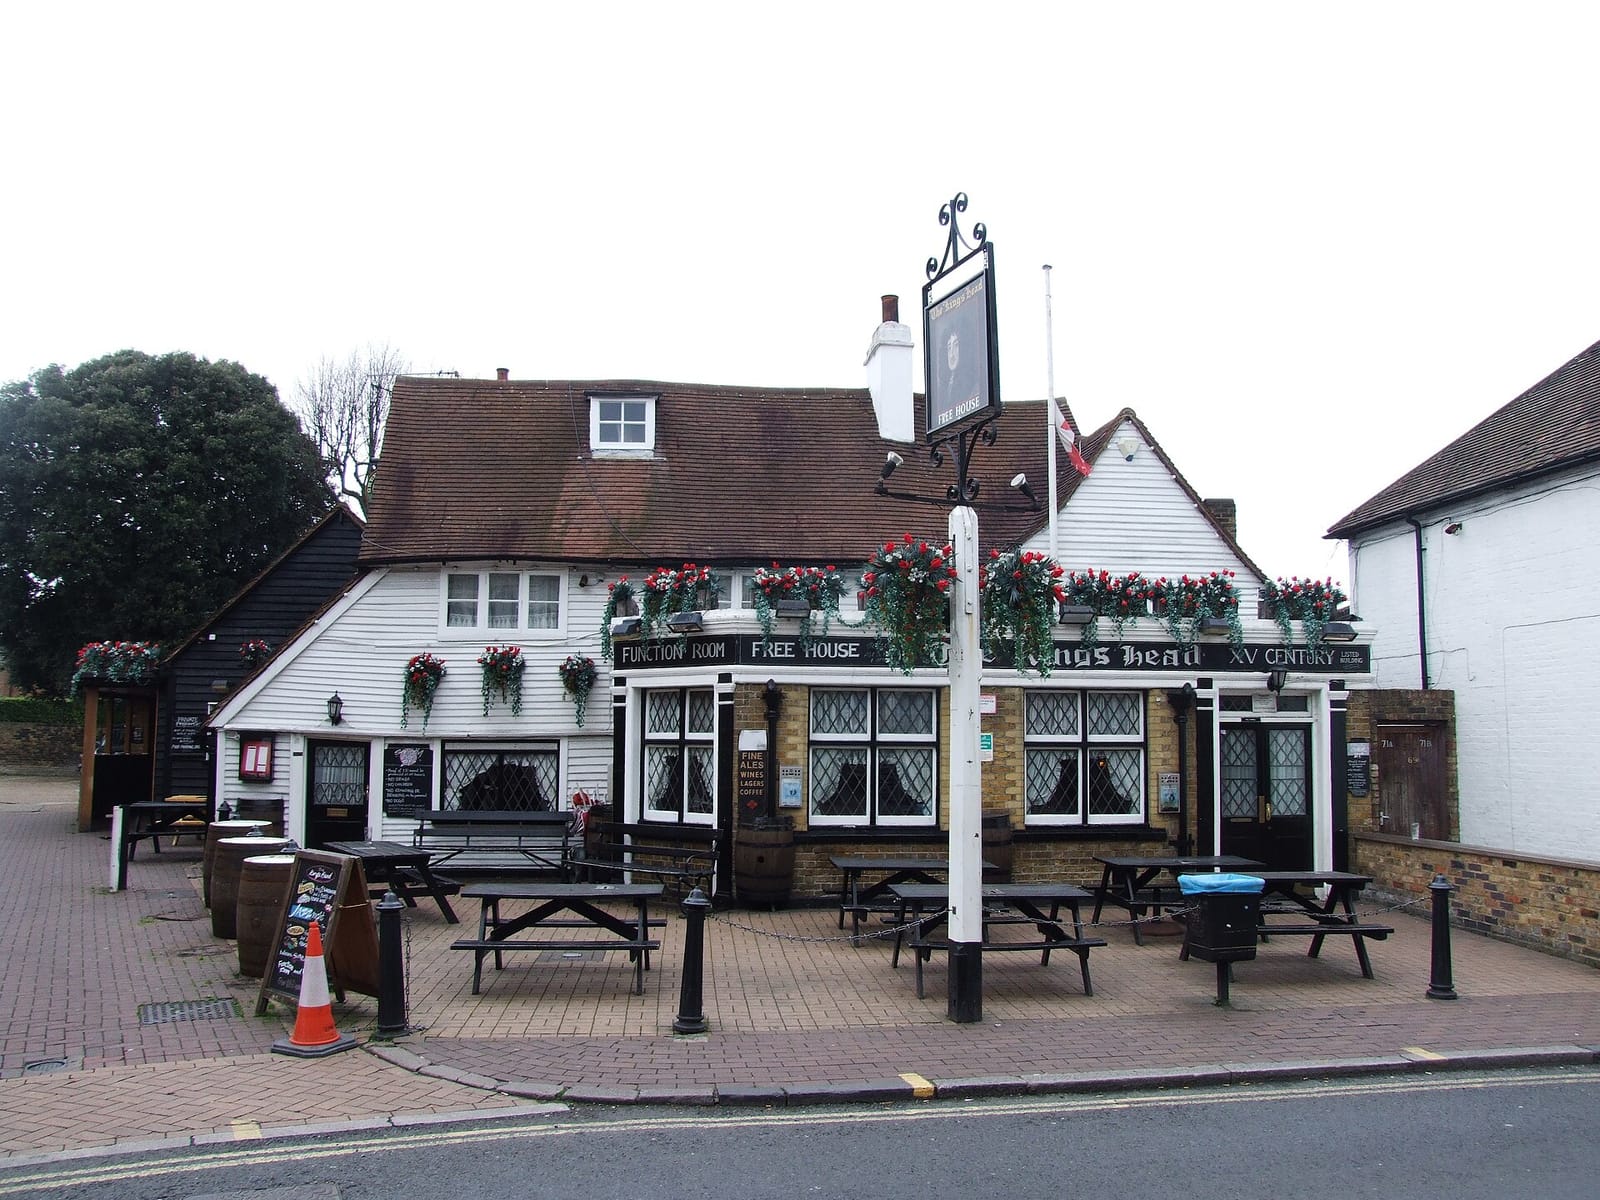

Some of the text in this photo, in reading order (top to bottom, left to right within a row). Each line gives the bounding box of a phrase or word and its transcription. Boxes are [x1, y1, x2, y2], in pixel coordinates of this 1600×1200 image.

[938, 396, 980, 425] FREE HOUSE
[622, 642, 725, 664] FUNCTION ROOM
[751, 641, 796, 658] FREE
[804, 642, 860, 658] HOUSE
[1228, 648, 1335, 665] XV CENTURY
[1381, 739, 1394, 748] 71A
[741, 752, 763, 760] FINE
[740, 761, 764, 769] ALES
